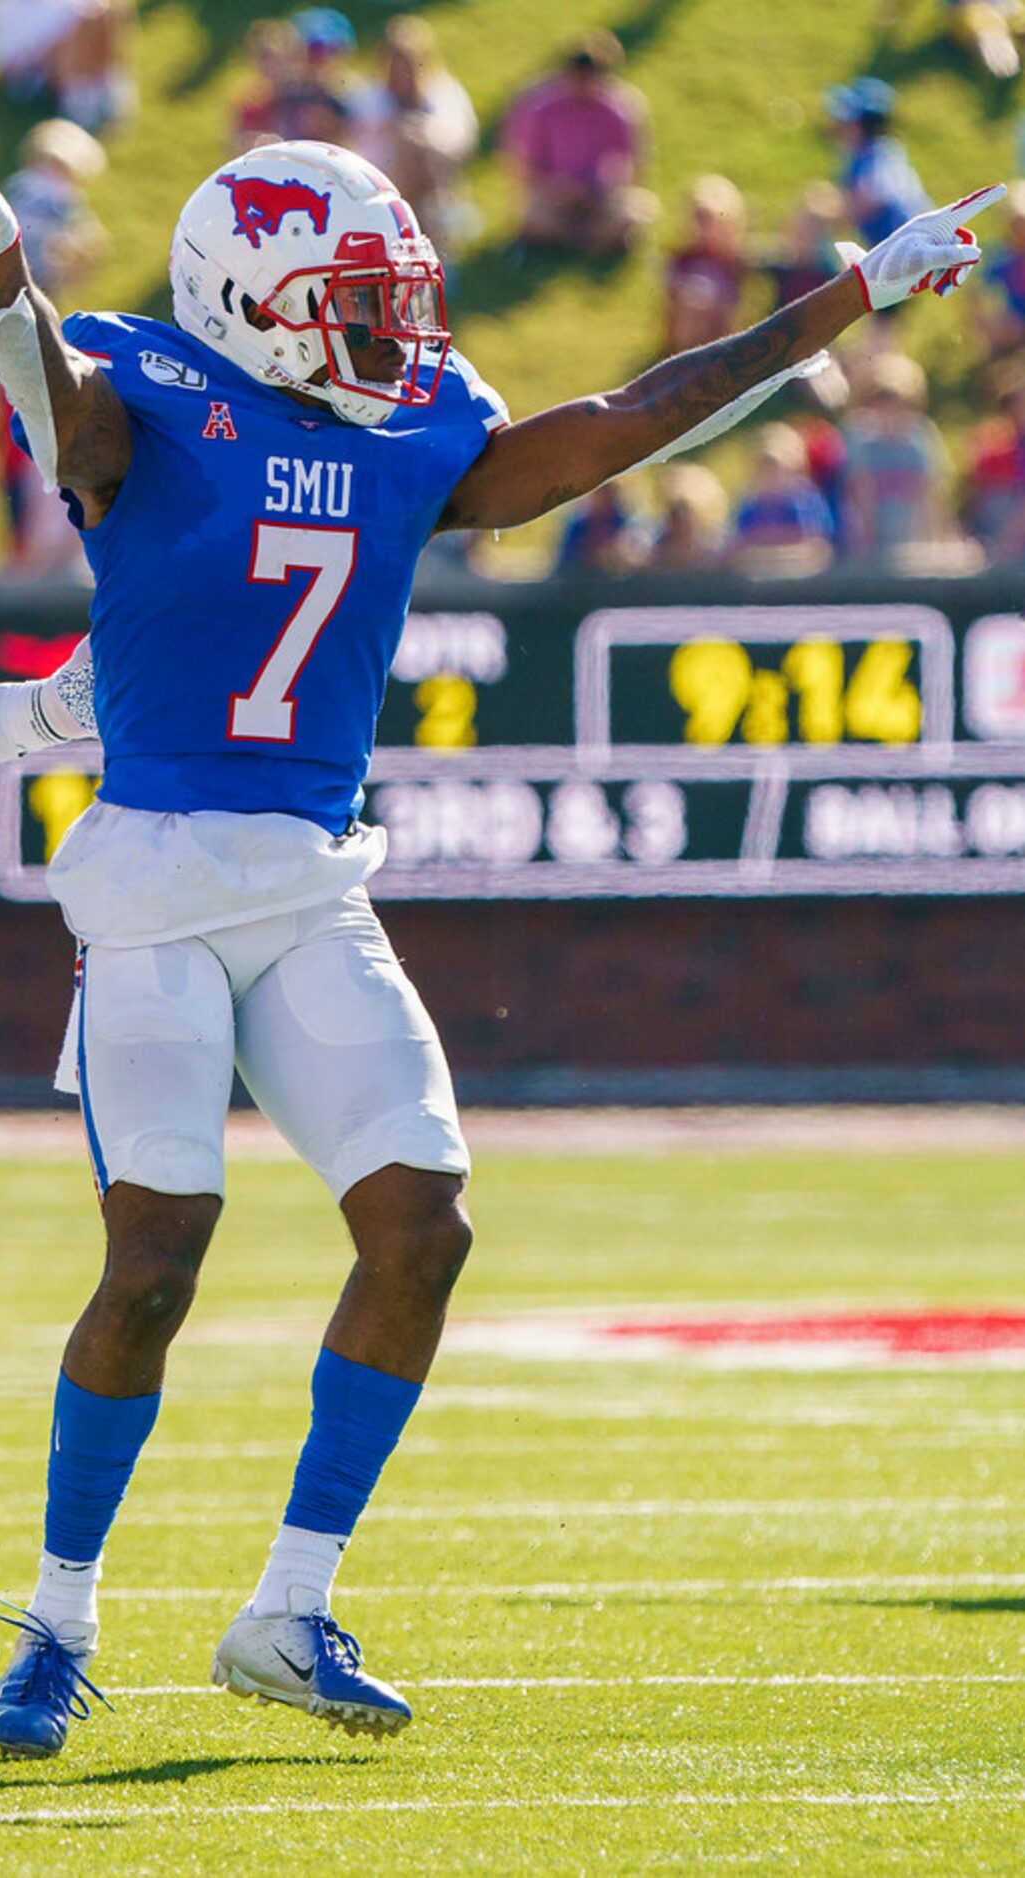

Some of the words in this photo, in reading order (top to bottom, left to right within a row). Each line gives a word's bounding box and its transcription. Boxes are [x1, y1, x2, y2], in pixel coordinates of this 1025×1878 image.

[138, 350, 207, 391] 150
[202, 401, 238, 440] A
[265, 456, 353, 517] SMU
[225, 519, 359, 745] 7
